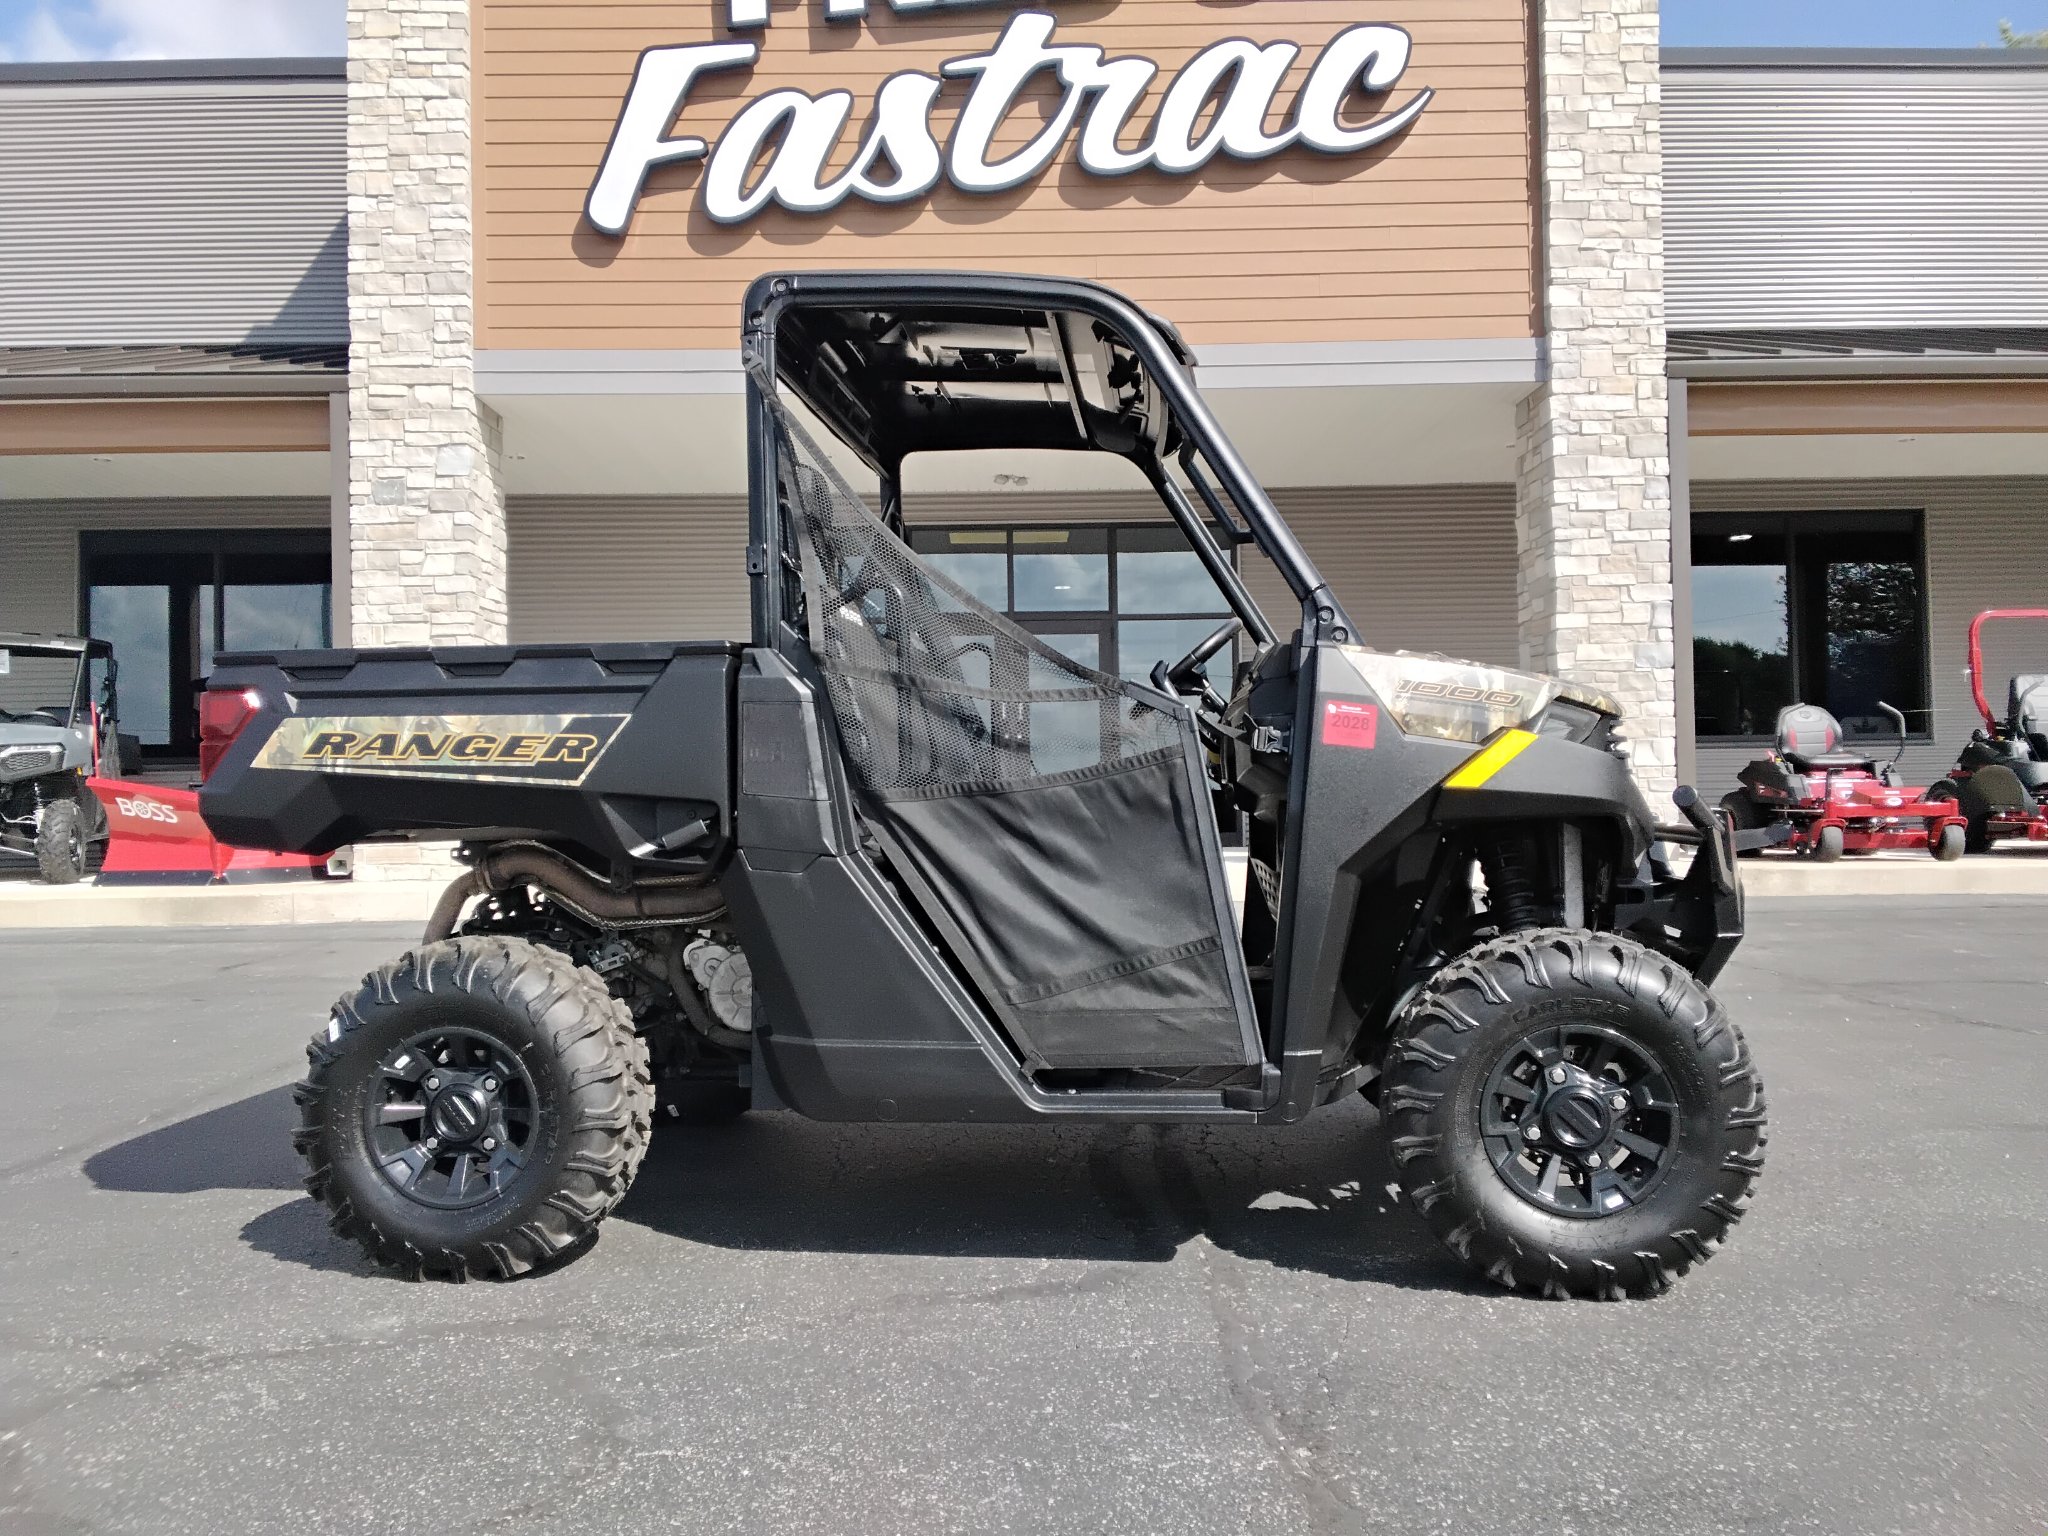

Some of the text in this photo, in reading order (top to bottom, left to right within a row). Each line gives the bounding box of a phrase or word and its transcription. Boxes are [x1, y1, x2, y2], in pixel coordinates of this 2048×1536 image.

[586, 10, 1435, 236] Fastrac
[1396, 680, 1523, 707] 1000
[1331, 713, 1370, 730] 2028
[303, 732, 598, 762] RANGER
[115, 797, 178, 823] BOSS
